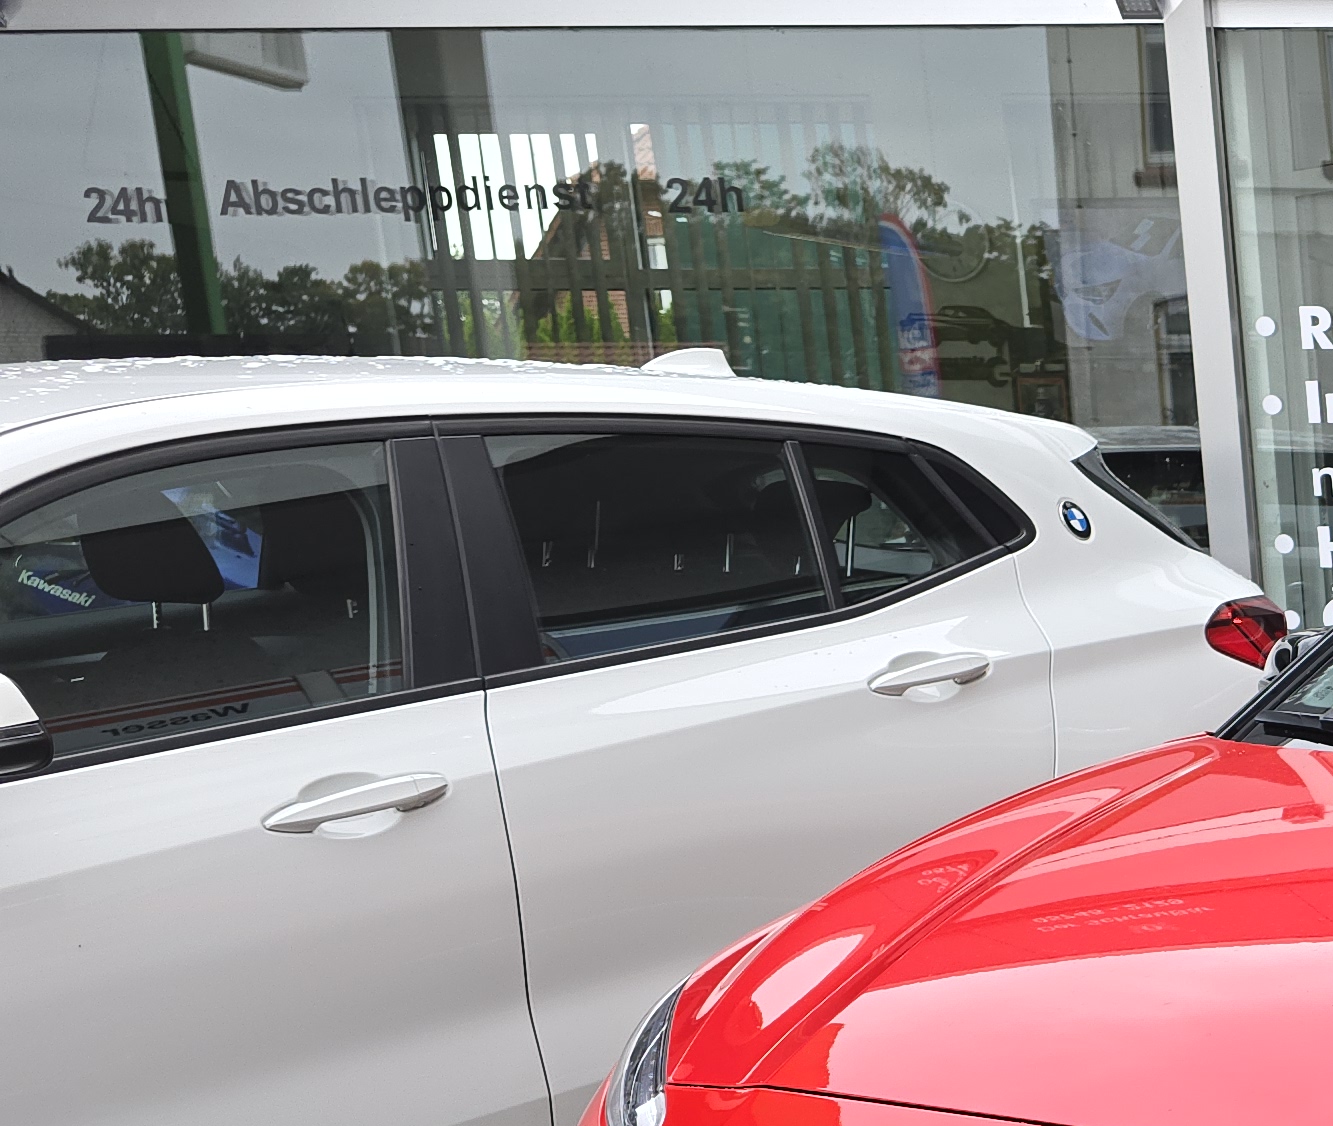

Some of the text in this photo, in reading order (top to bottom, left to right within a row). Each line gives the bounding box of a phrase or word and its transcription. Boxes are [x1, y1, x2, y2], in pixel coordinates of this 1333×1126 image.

[83, 176, 745, 223] 24h Abschleppdienst 24h
[18, 569, 97, 608] Kawasaki
